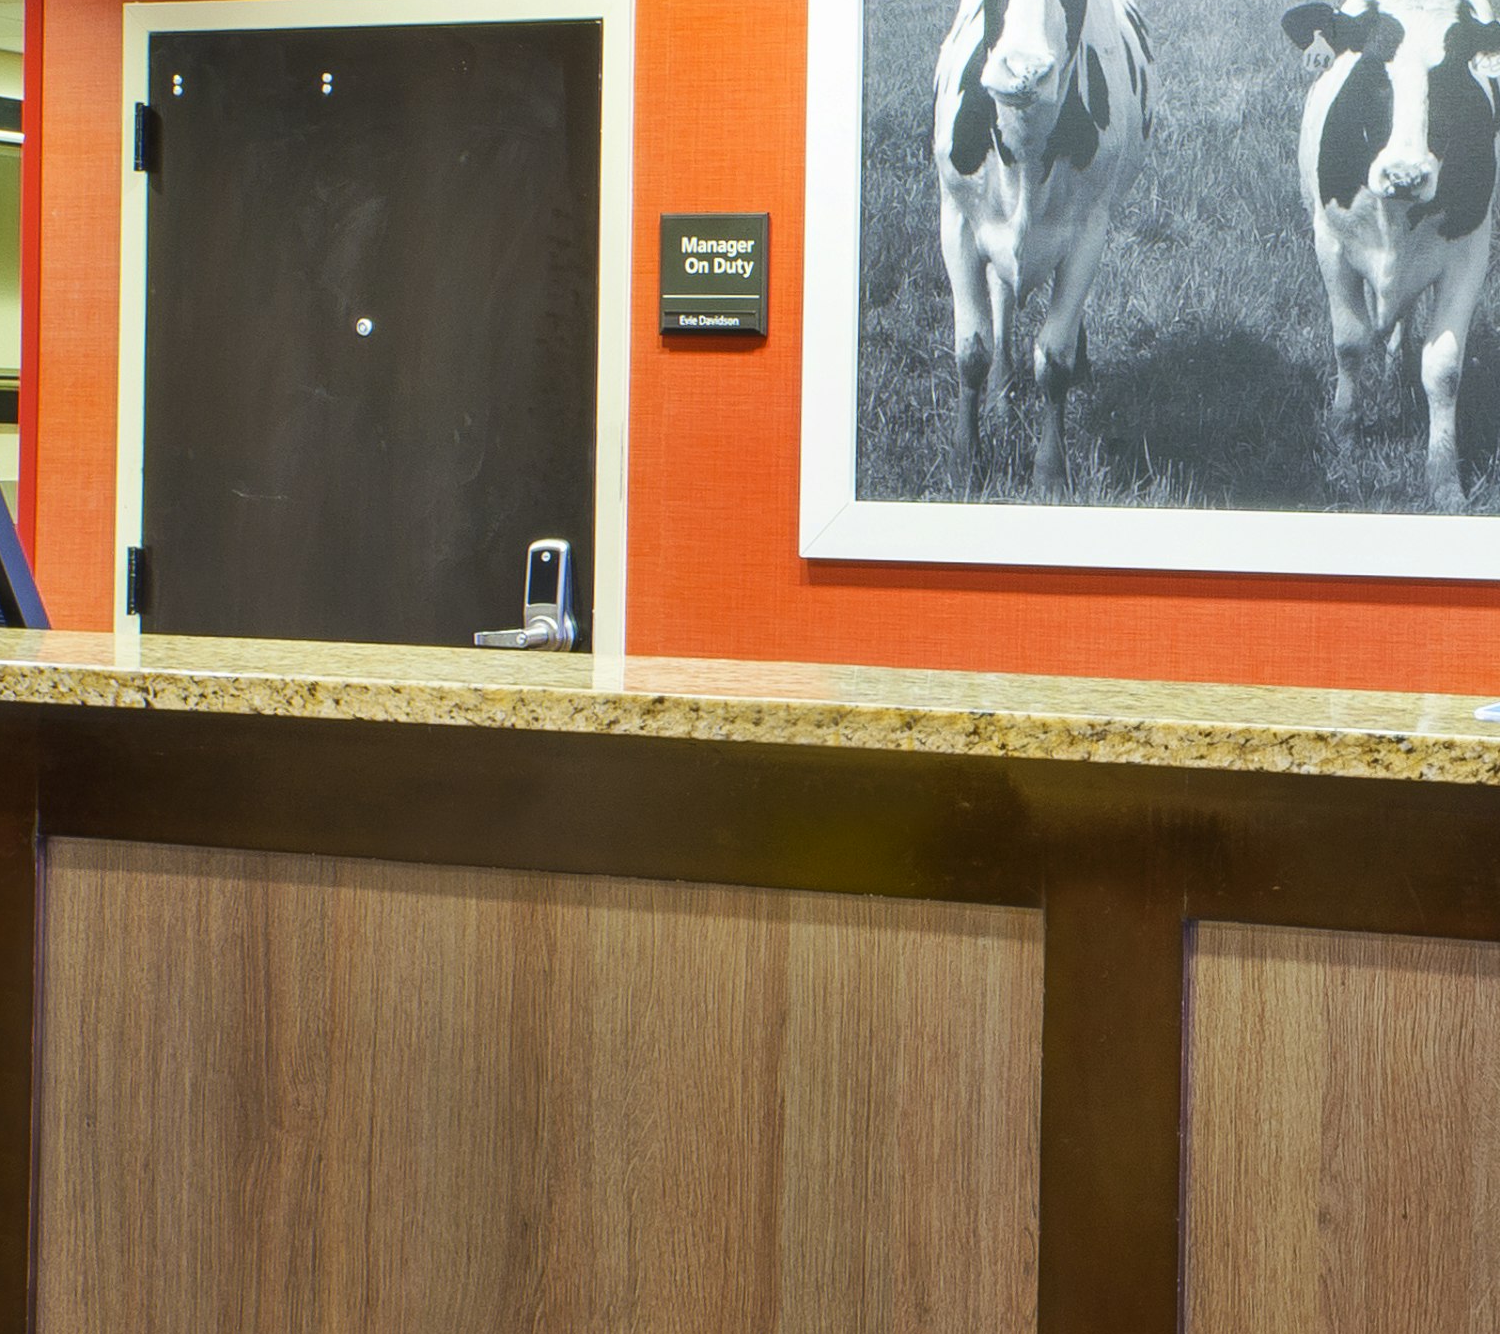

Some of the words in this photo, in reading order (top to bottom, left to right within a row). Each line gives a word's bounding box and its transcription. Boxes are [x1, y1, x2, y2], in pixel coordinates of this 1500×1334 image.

[681, 236, 755, 257] Manager
[685, 257, 710, 274] On
[713, 257, 754, 279] Duty
